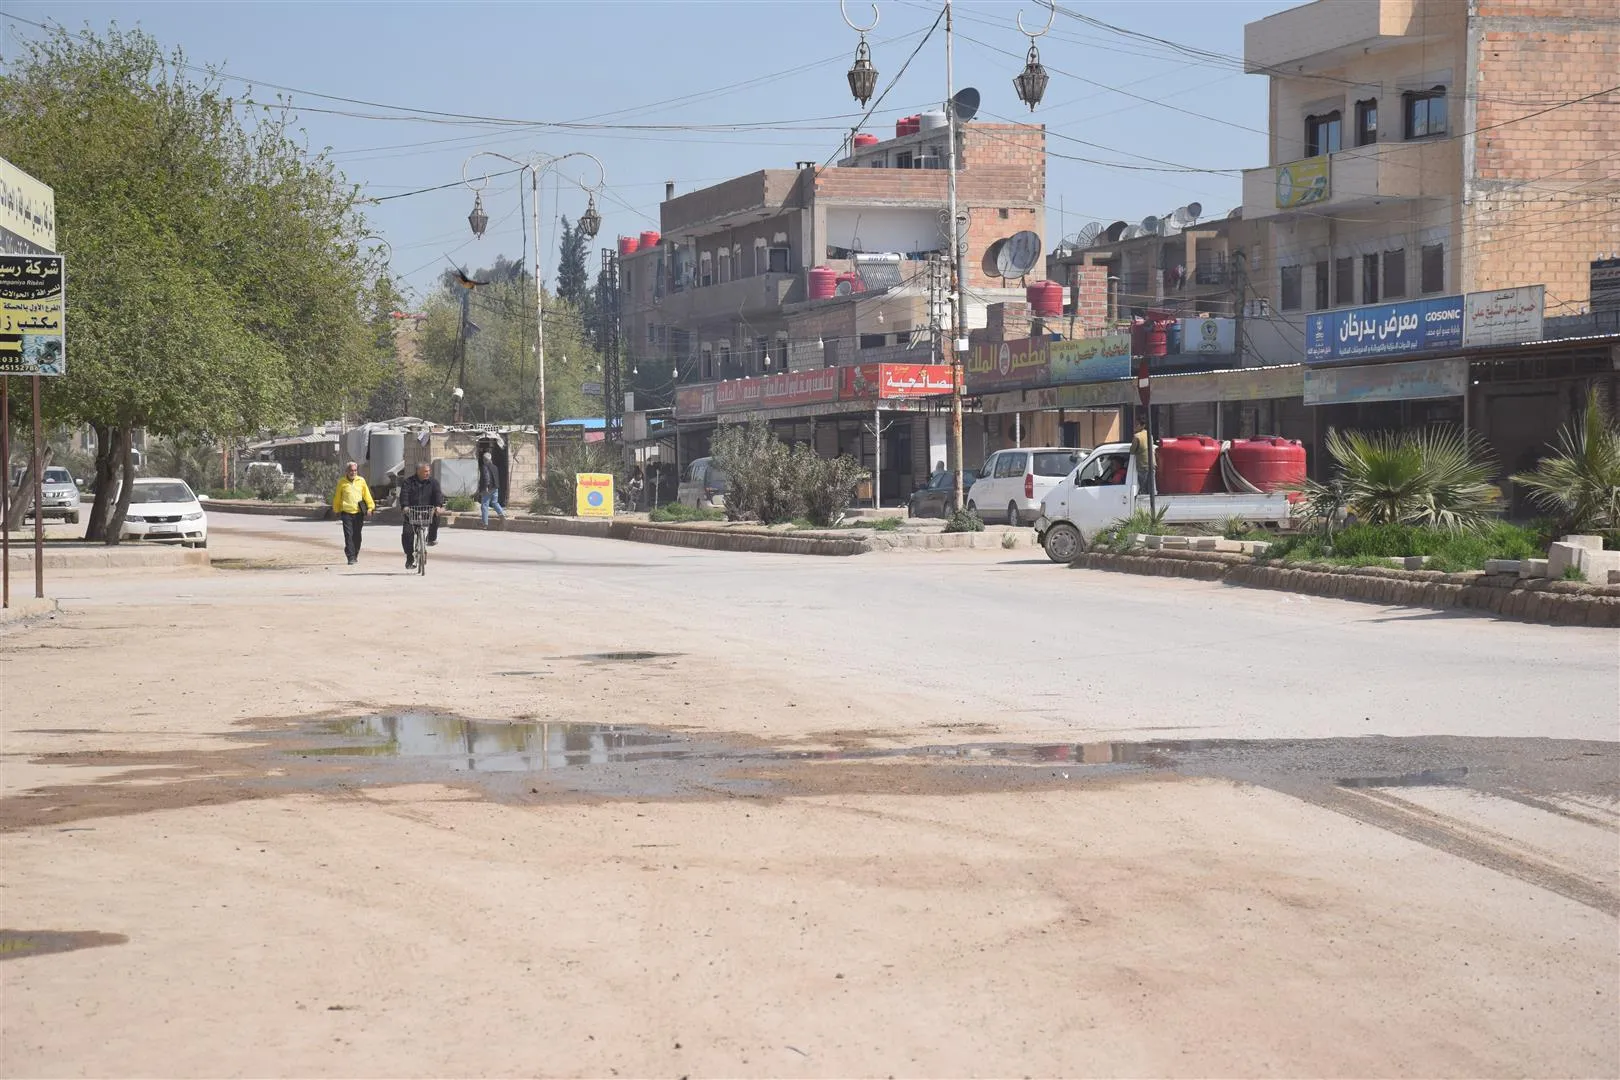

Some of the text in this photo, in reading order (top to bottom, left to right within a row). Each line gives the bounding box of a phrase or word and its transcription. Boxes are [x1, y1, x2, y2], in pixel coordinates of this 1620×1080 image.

[0, 259, 59, 278] شركة رسي
[4, 302, 28, 311] بالحسكة
[1425, 309, 1460, 322] GOSONIC
[17, 315, 58, 332] مكتب
[1340, 309, 1418, 342] معرض بدرخان
[968, 343, 997, 373] الملك
[1010, 338, 1046, 372] مطعم
[886, 370, 954, 392] صالحية
